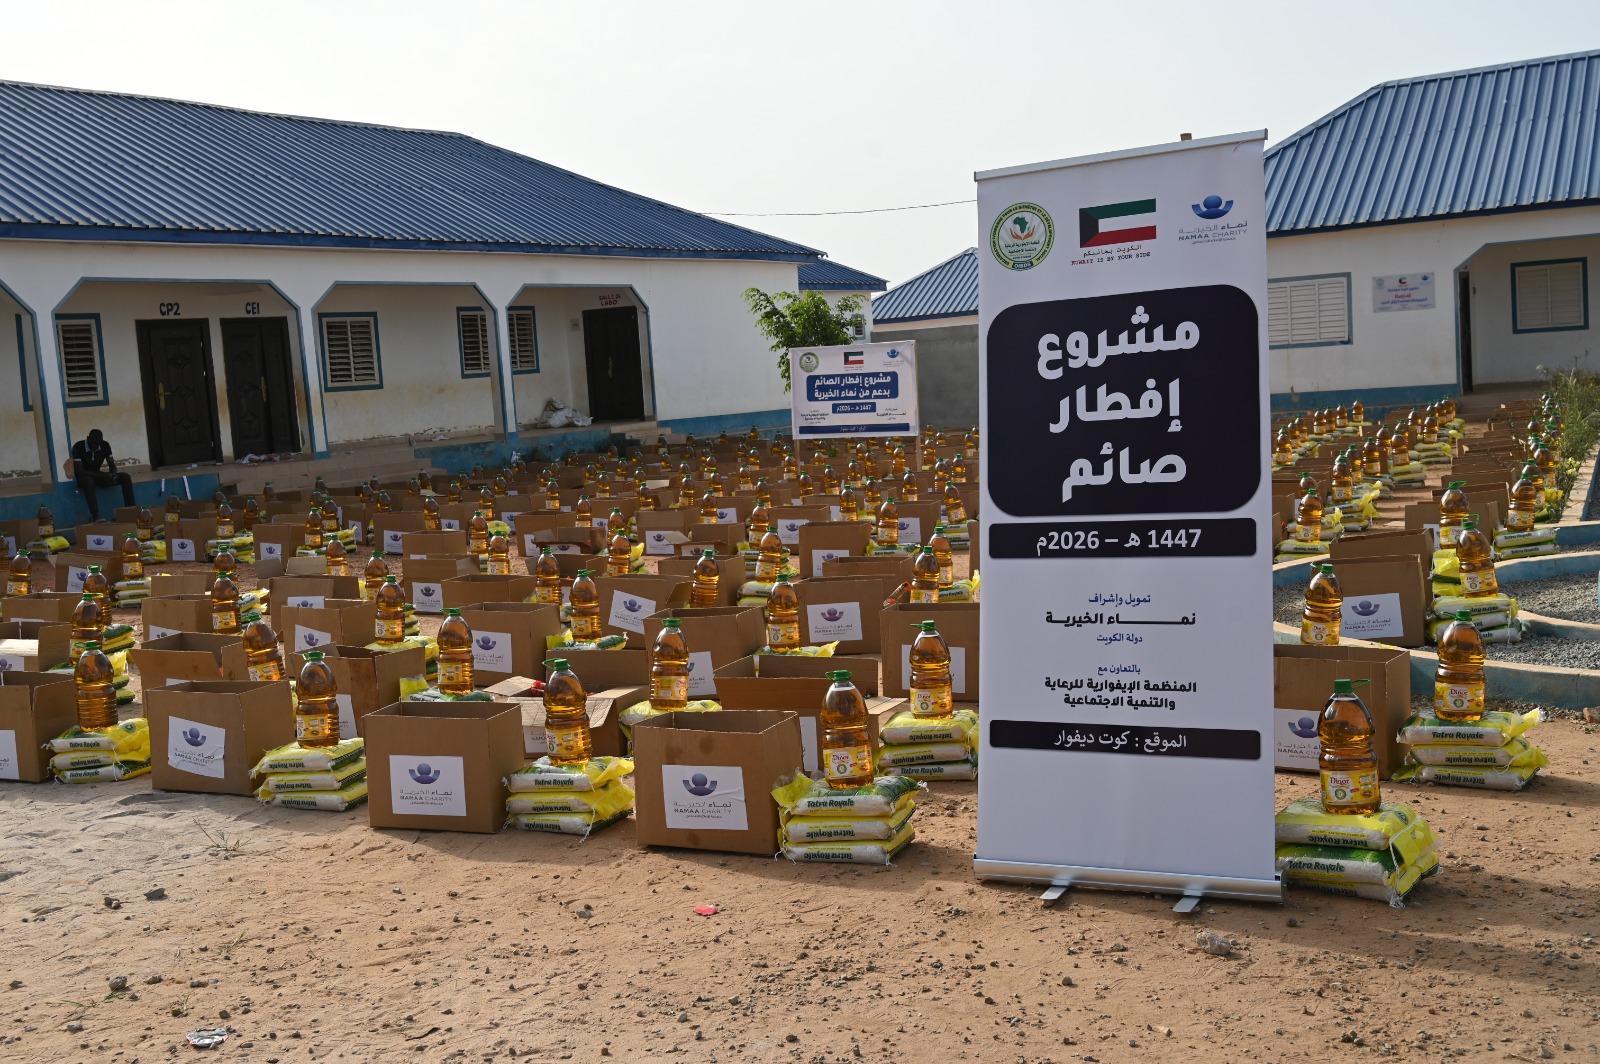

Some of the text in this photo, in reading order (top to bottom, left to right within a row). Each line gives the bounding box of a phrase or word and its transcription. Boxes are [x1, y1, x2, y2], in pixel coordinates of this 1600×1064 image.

[1221, 221, 1247, 229] نماء
[1212, 229, 1247, 237] CHARITY
[160, 302, 180, 316] CP2
[1037, 305, 1200, 379] مشروع
[815, 373, 891, 388] مشروع إفطار الصائم
[815, 389, 839, 400] الخيرية
[859, 389, 869, 398] من
[872, 388, 890, 399] بدعم
[1050, 378, 1182, 433] إفطار
[1062, 442, 1186, 503] صائم
[1036, 530, 1099, 556] 2026م
[1147, 528, 1201, 548] 1447
[1088, 593, 1151, 607] تمويل وإشراف
[1046, 611, 1103, 627] الخيرية
[1096, 633, 1142, 645] دولة الكويت
[1097, 664, 1141, 675] بالتعاون مع
[1045, 677, 1196, 694] المنظمة الإيفوارية للرعاية
[1064, 693, 1175, 710] والتنمية الاجتماعية
[1054, 730, 1095, 747] ديفوار
[1099, 730, 1130, 749] كوت
[1432, 731, 1454, 739] Tatra
[1455, 731, 1484, 742] Royale
[1143, 734, 1186, 752] الموقع
[891, 756, 914, 764] Royale
[1445, 755, 1472, 763] Royale
[920, 767, 944, 775] Royale
[1434, 774, 1461, 783] Royale
[807, 798, 854, 809] Tatra Royale
[806, 829, 831, 839] Royale
[1308, 835, 1340, 844] Royale
[804, 852, 829, 860] Royale
[1288, 861, 1345, 873] Tatra Royale
